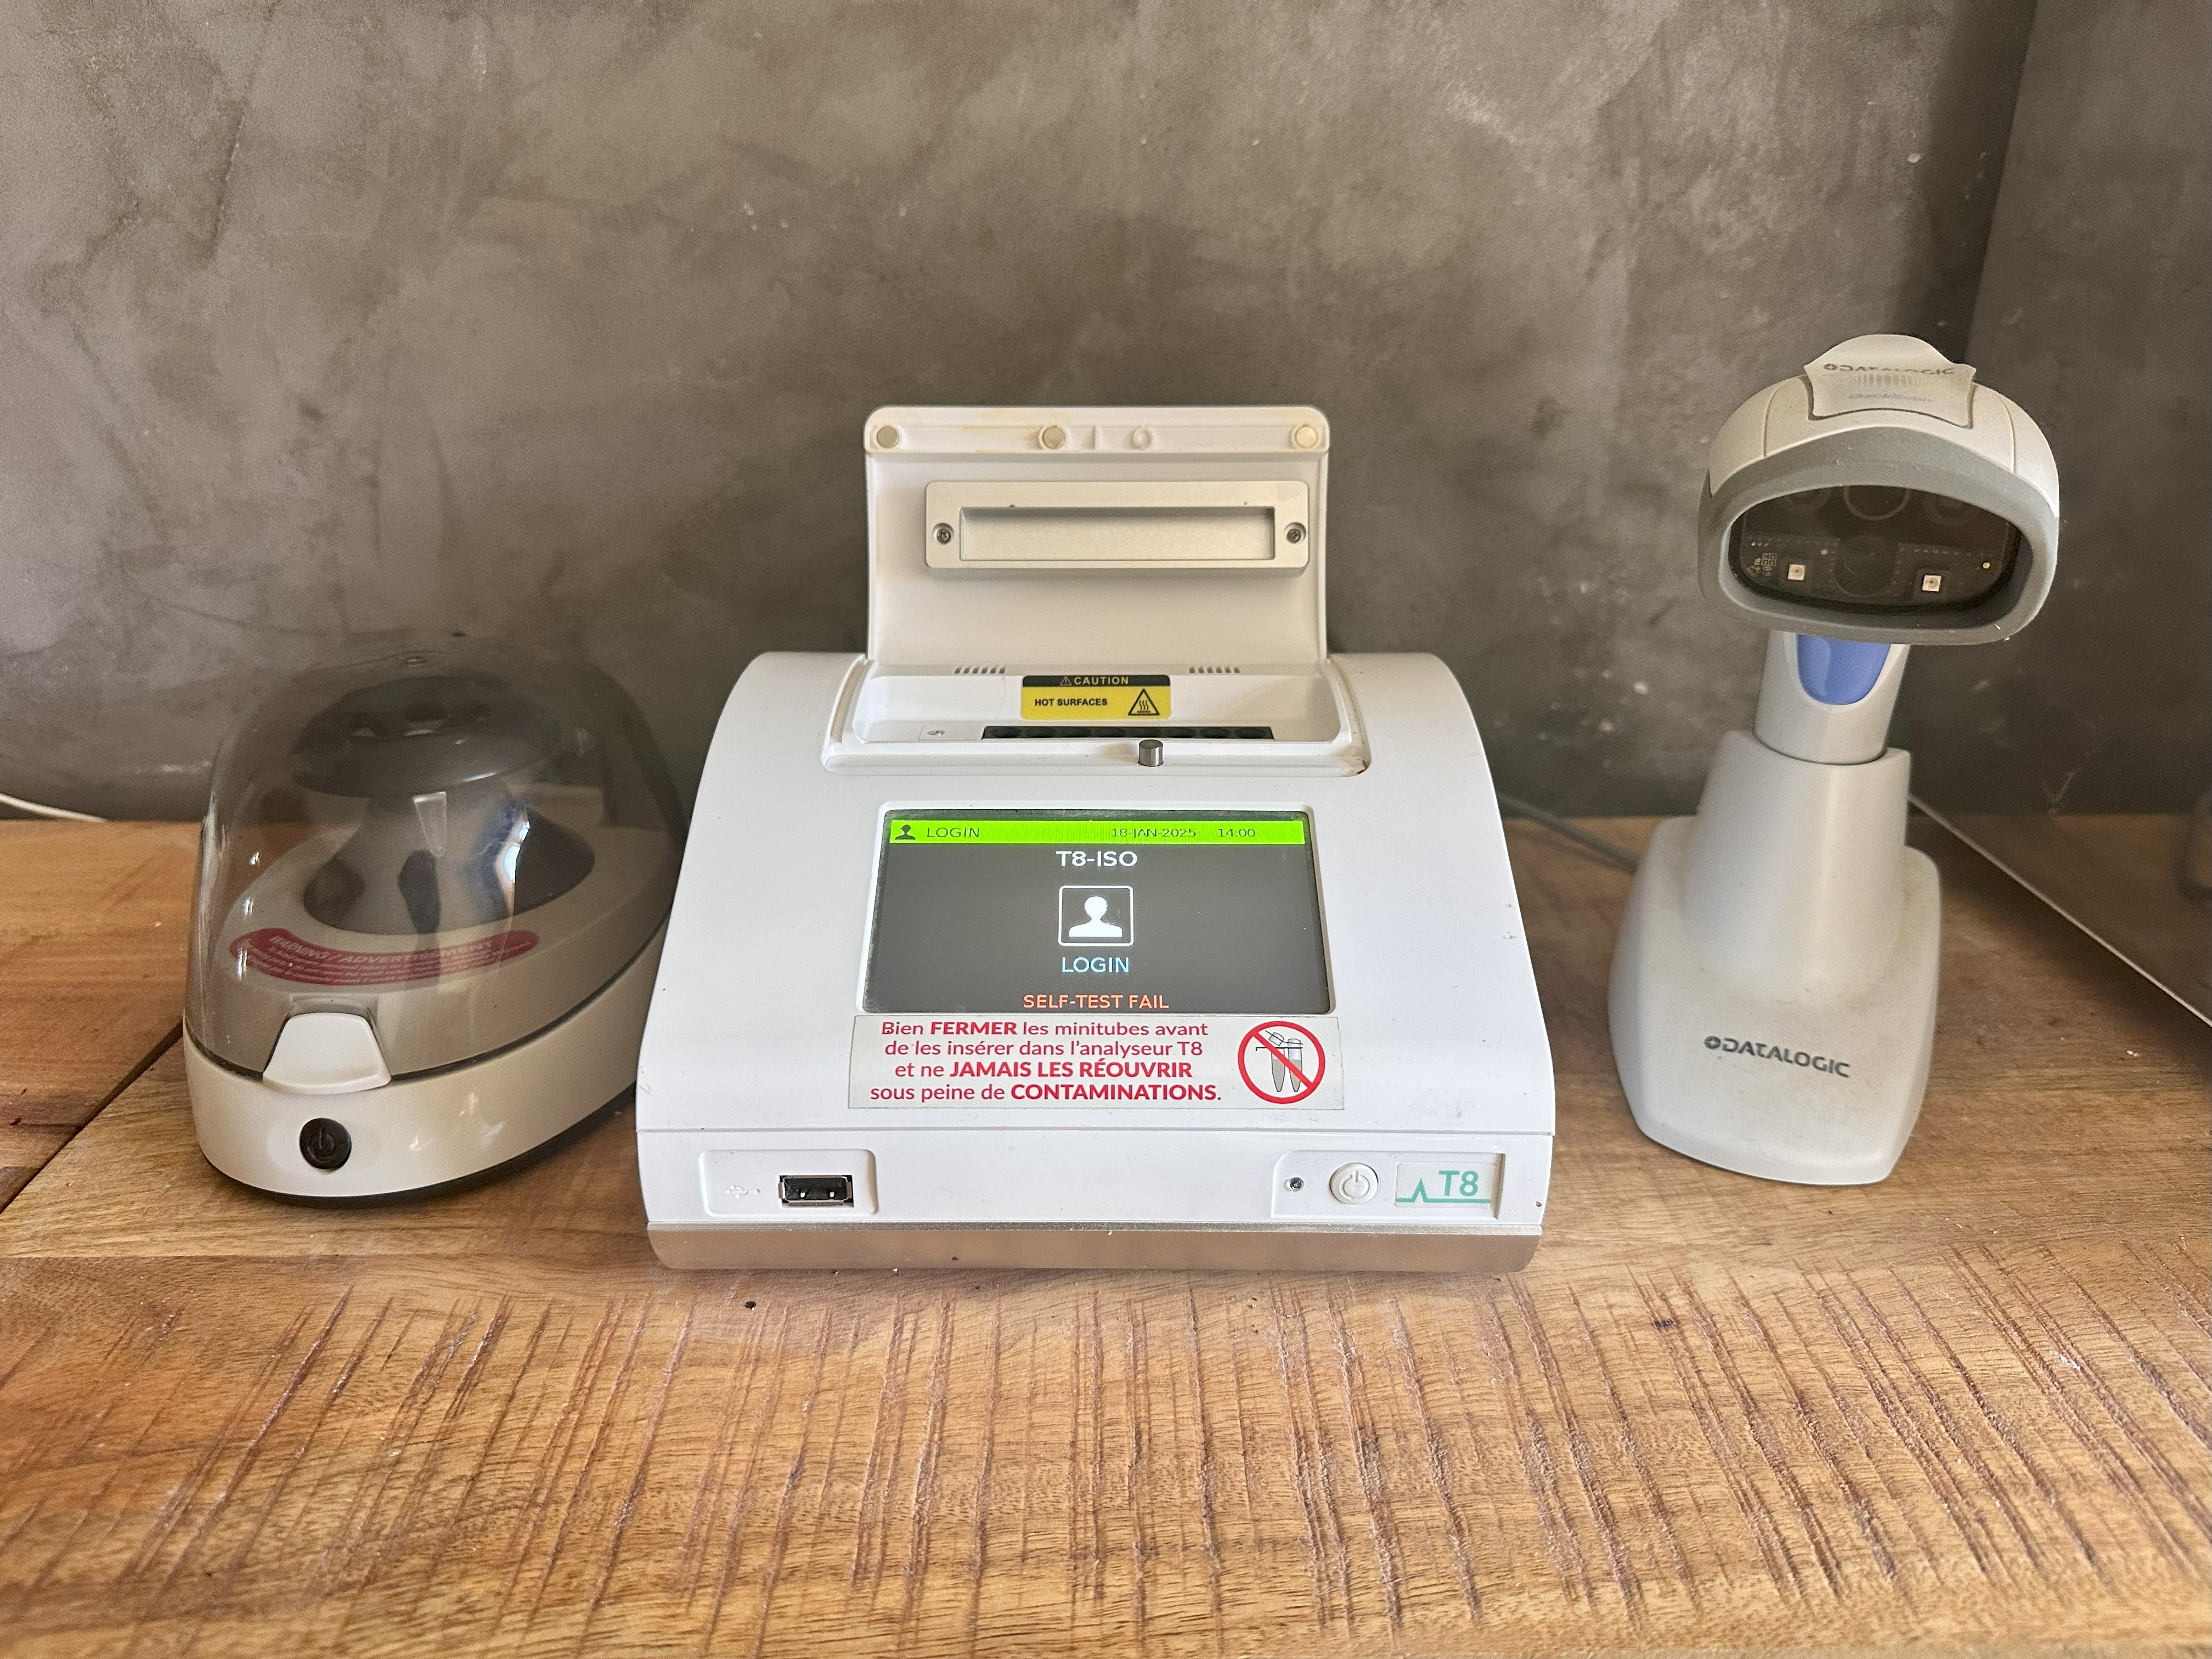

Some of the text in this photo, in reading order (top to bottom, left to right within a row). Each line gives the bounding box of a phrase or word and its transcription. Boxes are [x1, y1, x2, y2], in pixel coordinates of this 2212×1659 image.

[1074, 676, 1129, 685] CAUTION
[1035, 698, 1108, 707] HOT SURFACES
[926, 827, 1256, 839] LOGIN 18-JAN-2025 14:00
[1056, 850, 1138, 867] T8-ISO
[1061, 956, 1130, 973] LOGIN
[1023, 994, 1170, 1009] SELF-TEST FAIL
[882, 1021, 1207, 1036] Bien FERMER les minitubes avant
[884, 1041, 909, 1056] de
[915, 1041, 941, 1055] les
[947, 1041, 1013, 1056] insérer
[1019, 1041, 1065, 1056] dans
[1177, 1041, 1203, 1056] T8
[1722, 1037, 1851, 1078] DATALOGIC
[894, 1057, 1192, 1078] et ne JAMAIS LES RÉOUVRIR
[870, 1083, 1222, 1103] sous peine de CONTAMINATIONS.
[1438, 1170, 1479, 1196] T8
